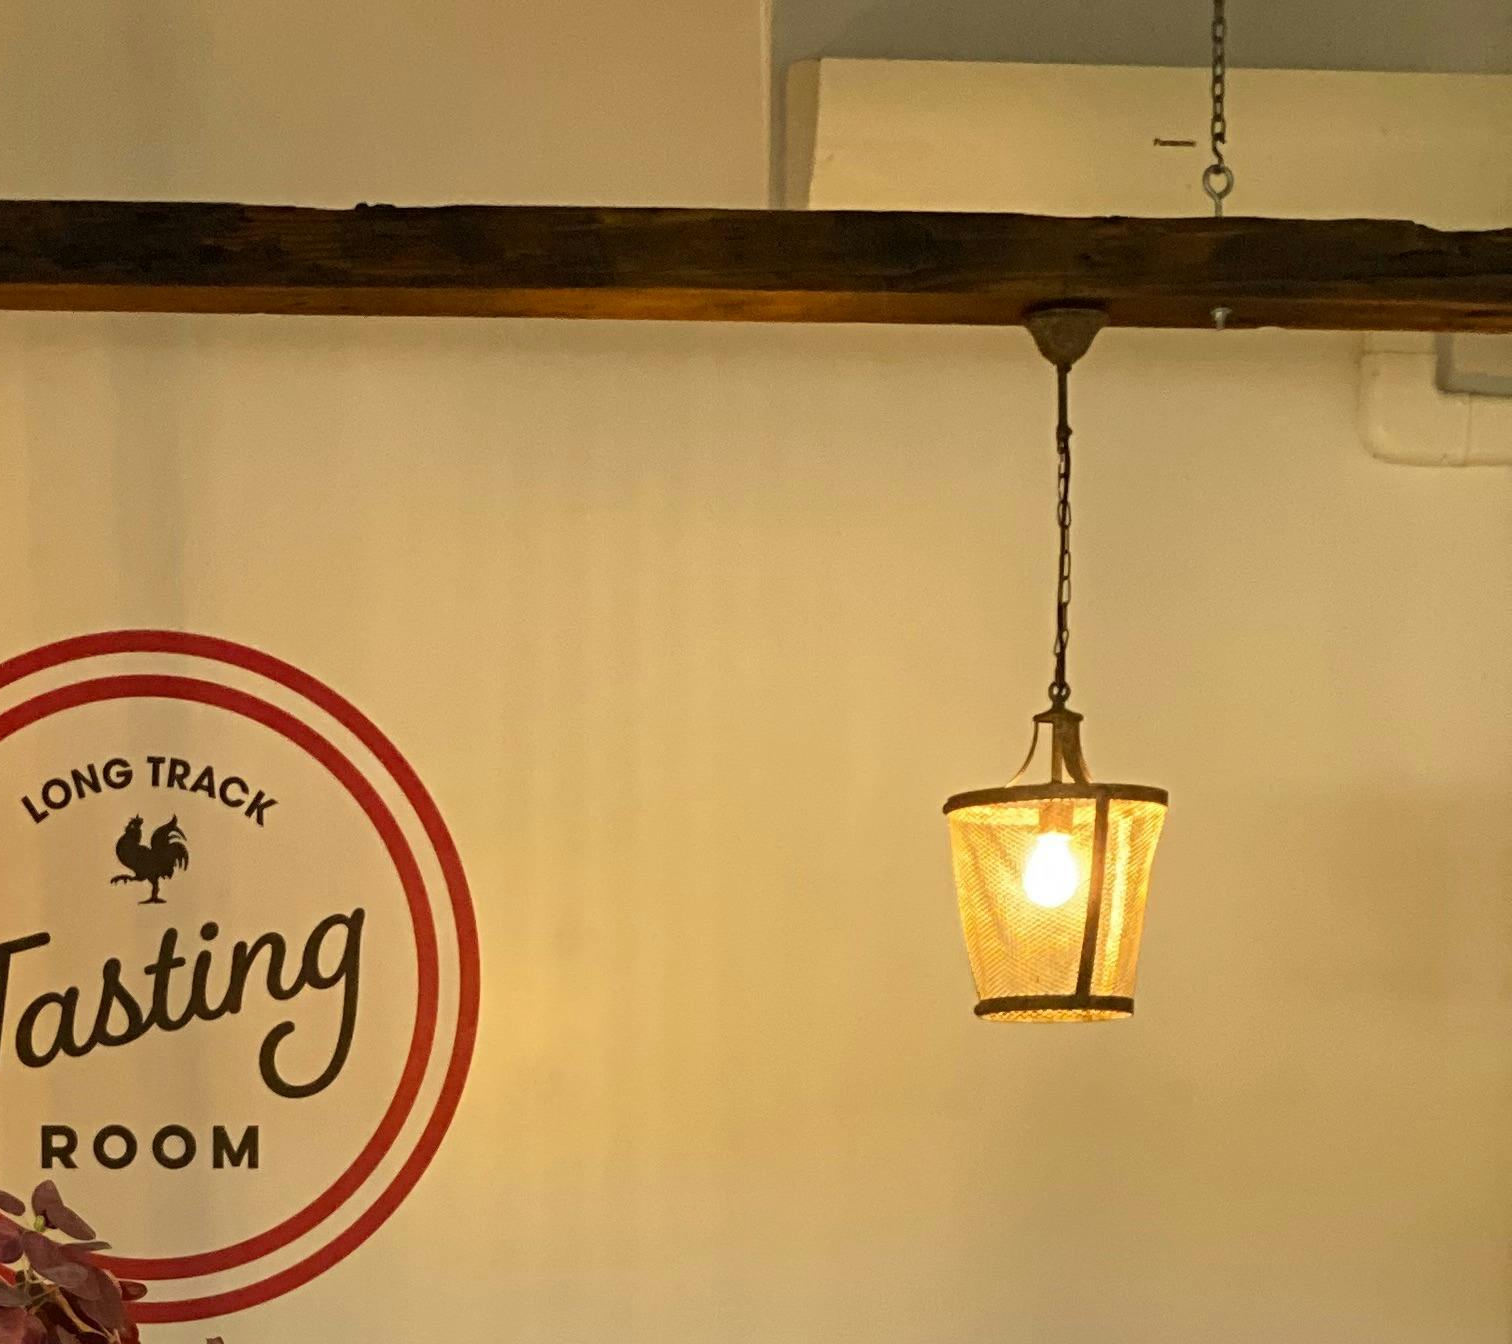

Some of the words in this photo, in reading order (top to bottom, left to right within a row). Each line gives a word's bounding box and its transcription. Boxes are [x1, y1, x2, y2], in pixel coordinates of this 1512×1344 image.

[21, 758, 133, 824] LONG
[147, 756, 279, 827] TRACK
[40, 1124, 260, 1170] ROOM
